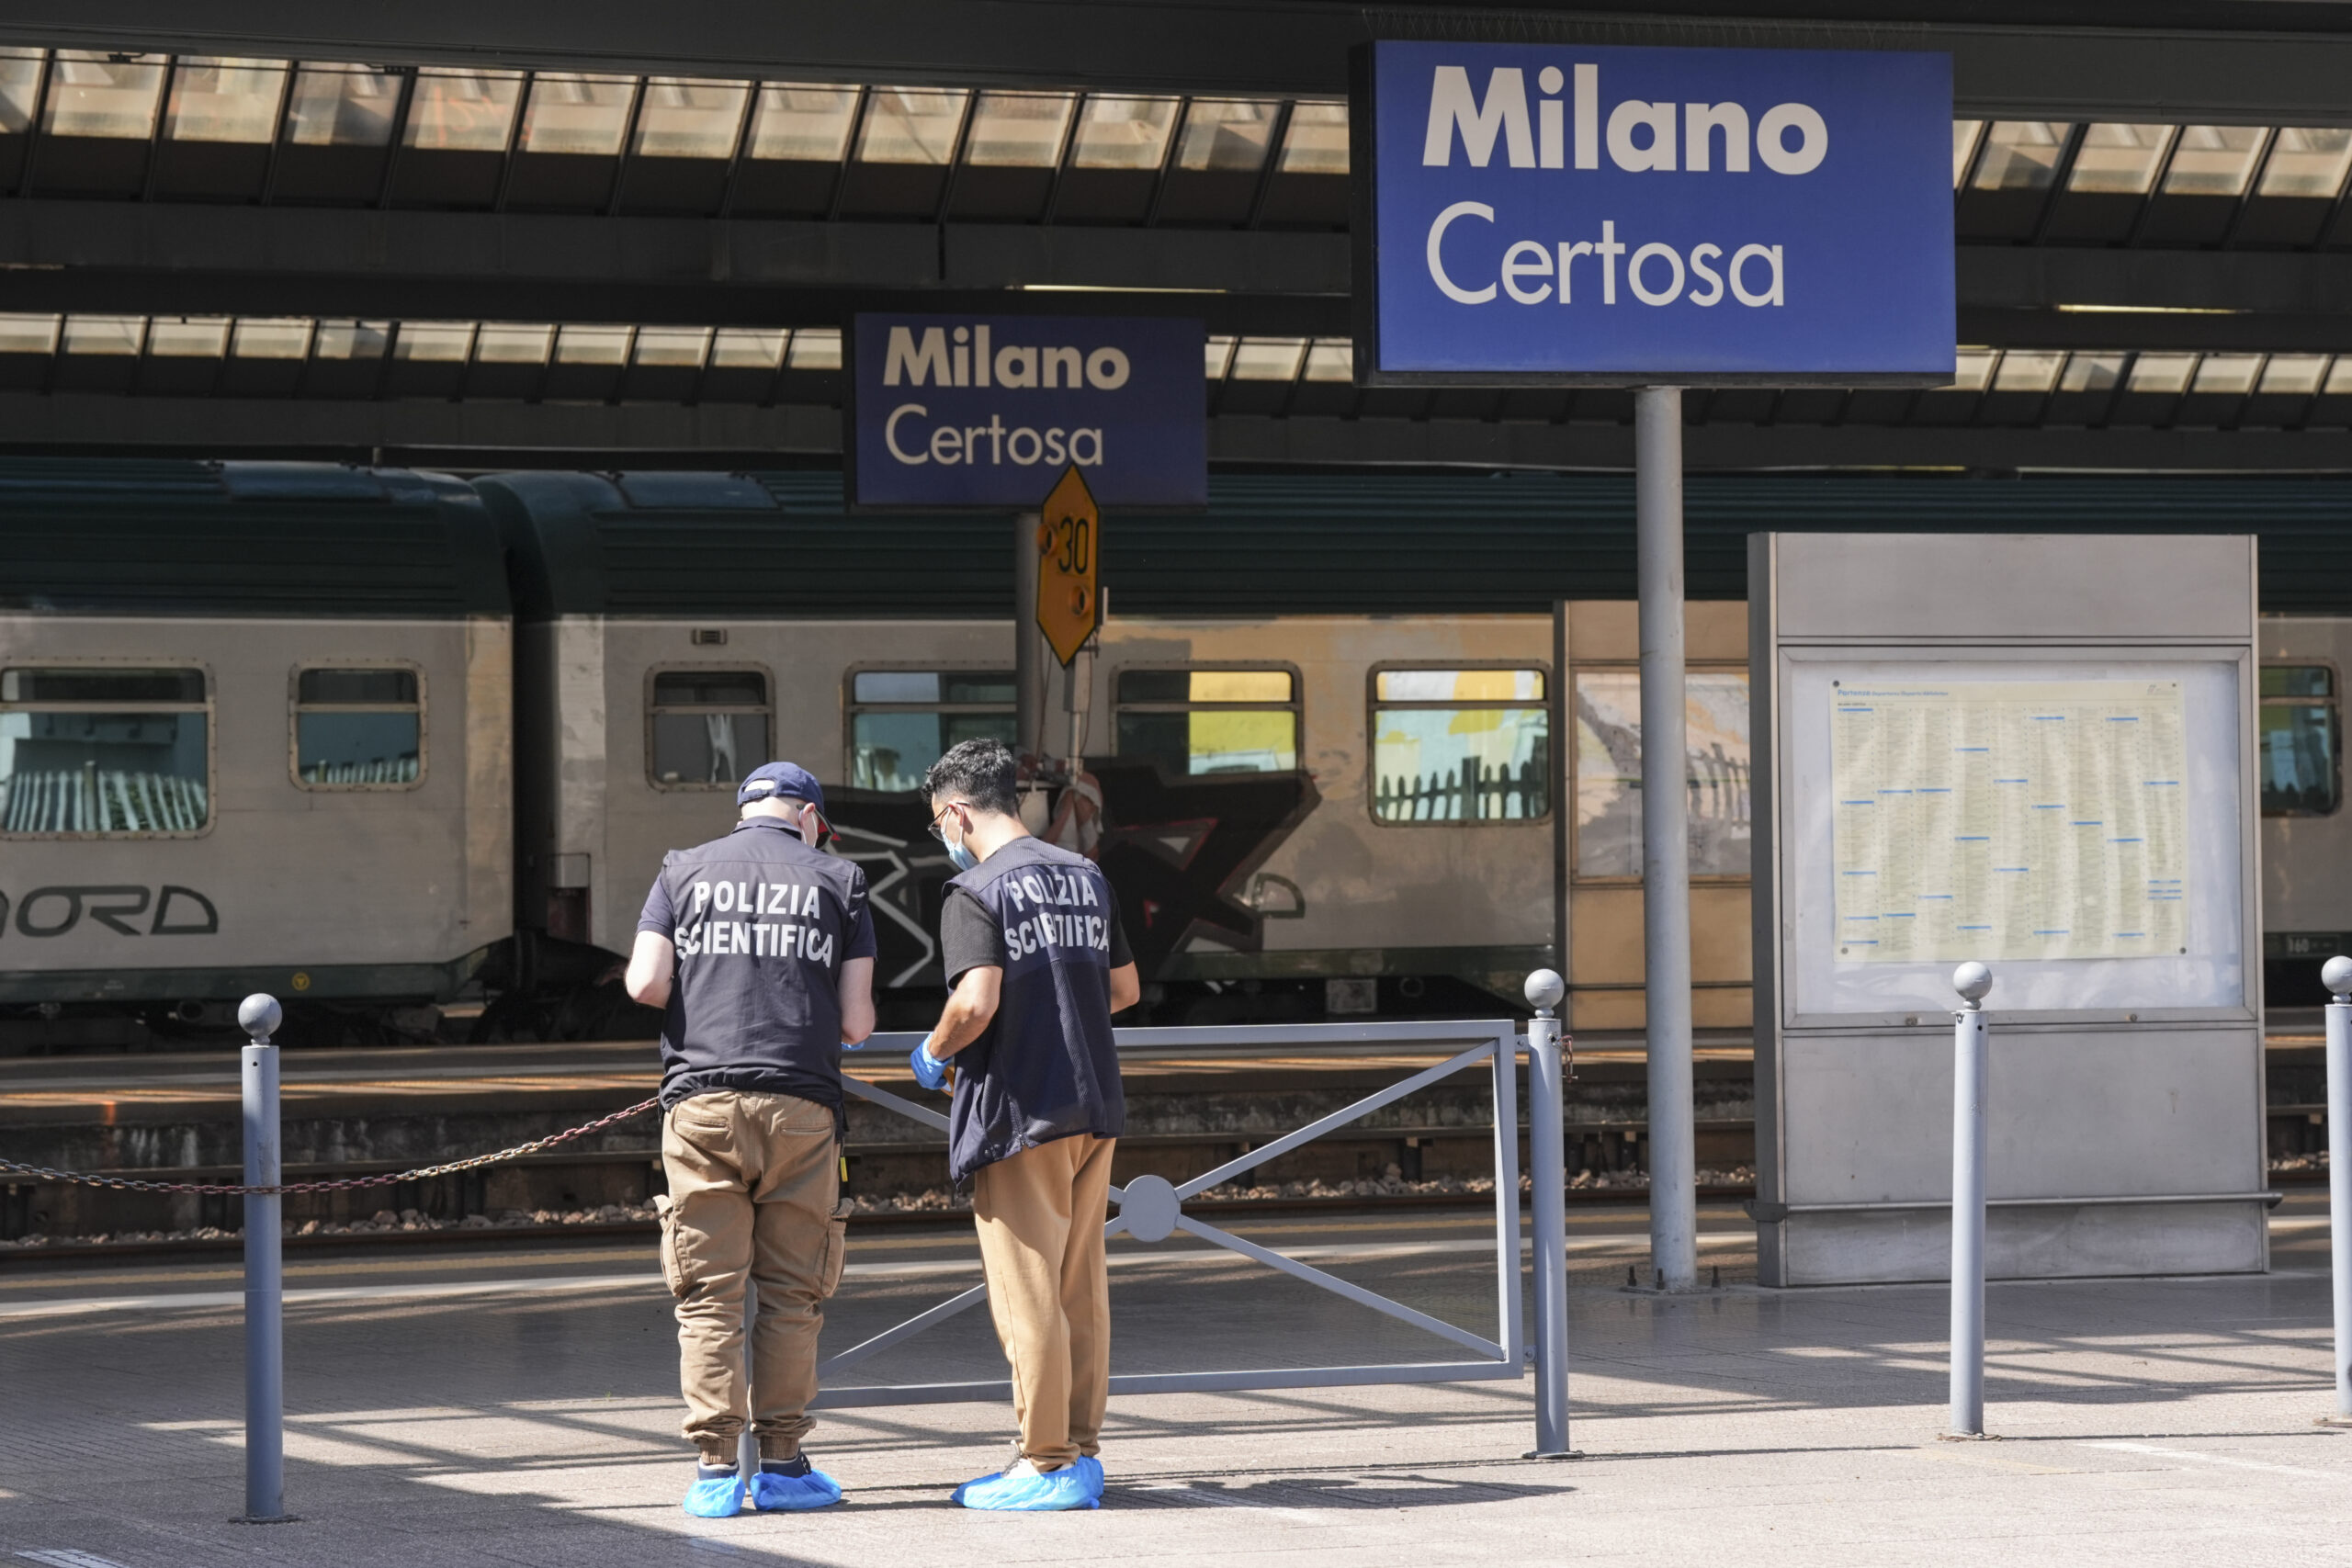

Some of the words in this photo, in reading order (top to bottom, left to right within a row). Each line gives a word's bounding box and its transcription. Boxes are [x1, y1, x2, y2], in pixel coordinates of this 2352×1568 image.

[1422, 63, 1828, 175] Milano
[1427, 200, 1783, 307] Certosa
[883, 324, 1130, 389] Milano
[885, 403, 1102, 466] Certosa
[1057, 516, 1089, 575] 30
[0, 884, 219, 938] ORD
[694, 880, 820, 919] POLIZIA
[1005, 874, 1099, 912] POLIZIA
[673, 921, 833, 968] SCIENTIFICA
